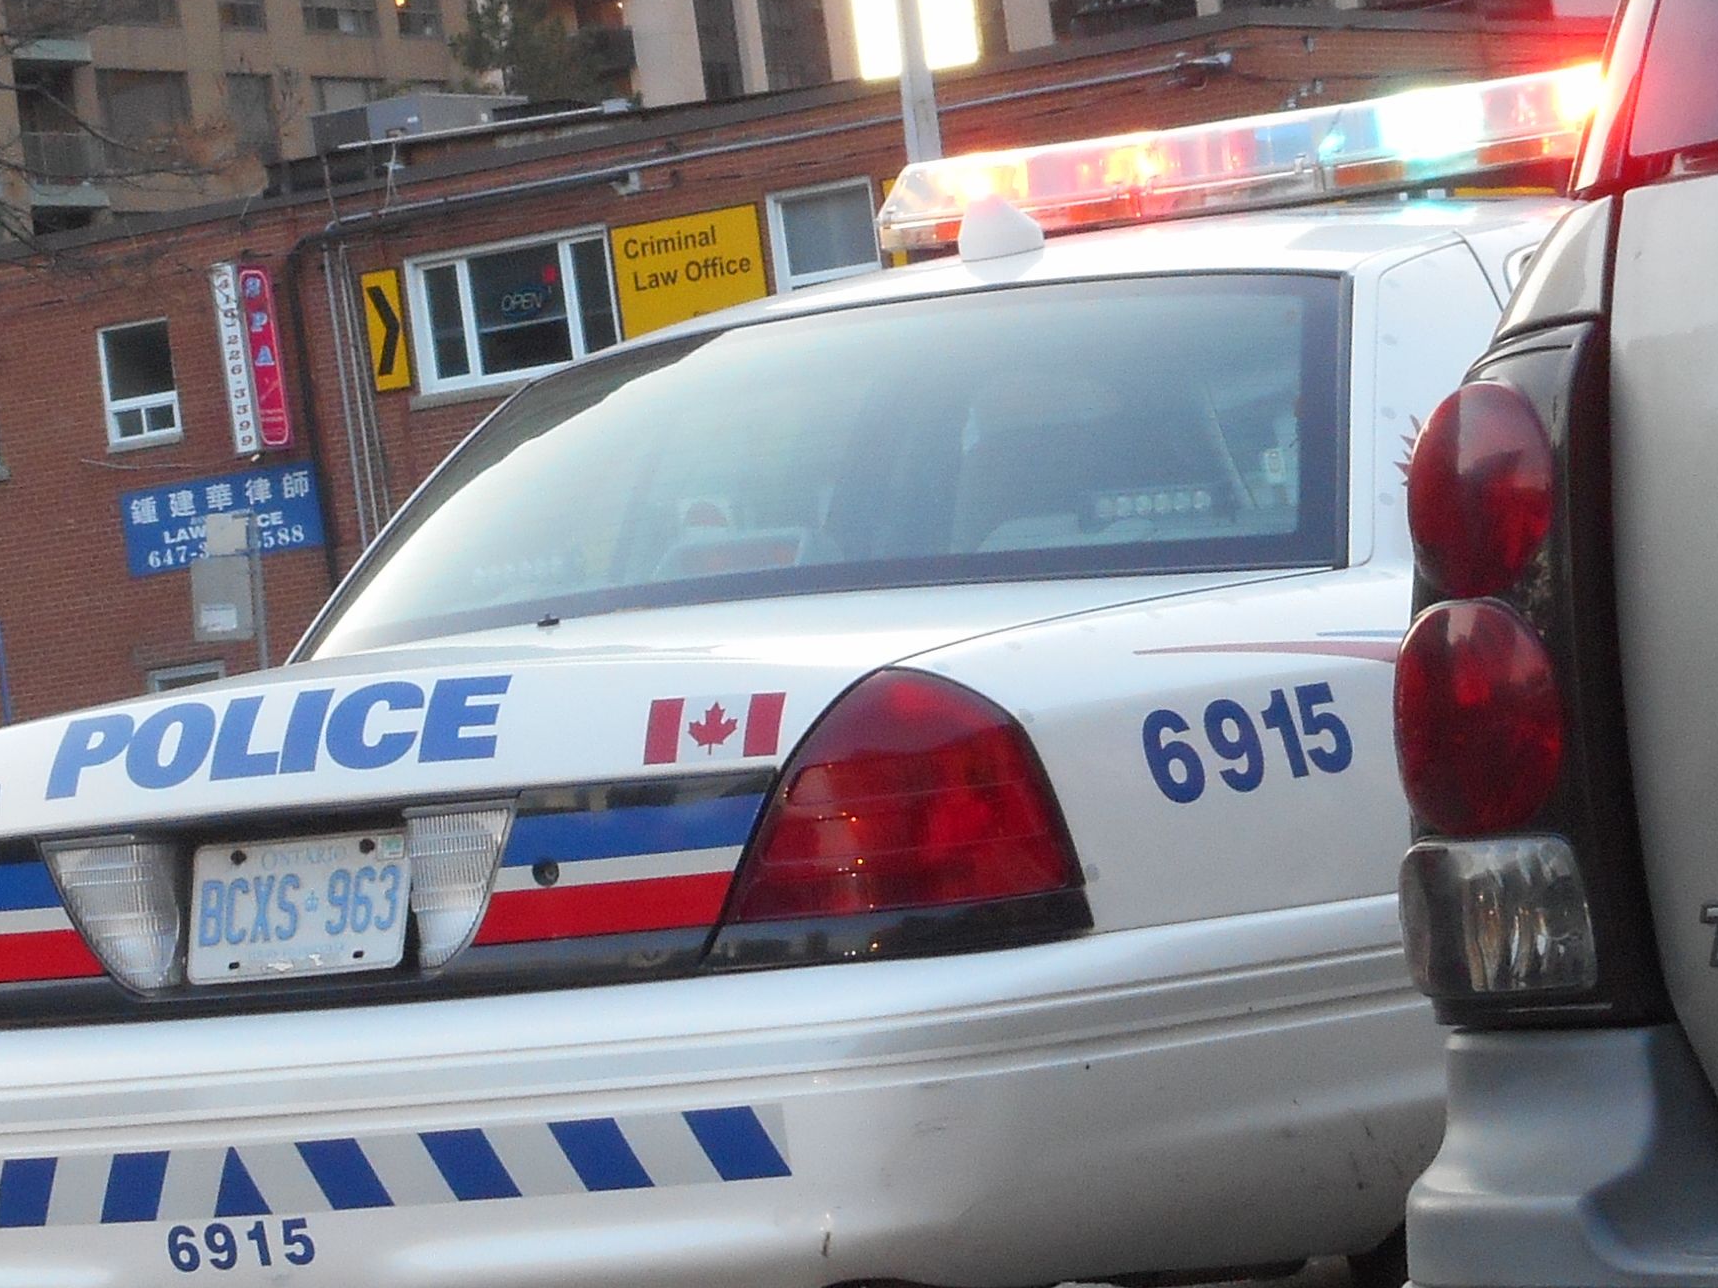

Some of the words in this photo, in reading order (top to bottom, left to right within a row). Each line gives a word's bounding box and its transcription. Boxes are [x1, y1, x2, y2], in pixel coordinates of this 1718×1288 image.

[623, 225, 716, 260] Criminal
[634, 268, 678, 292] Law
[685, 256, 751, 282] Office
[501, 292, 543, 312] OPEN
[163, 525, 208, 544] LAW
[46, 675, 512, 799] POLICE
[1142, 682, 1354, 804] 6915
[198, 873, 300, 947] BCXS
[325, 864, 401, 936] 963
[167, 1216, 315, 1273] 6915
